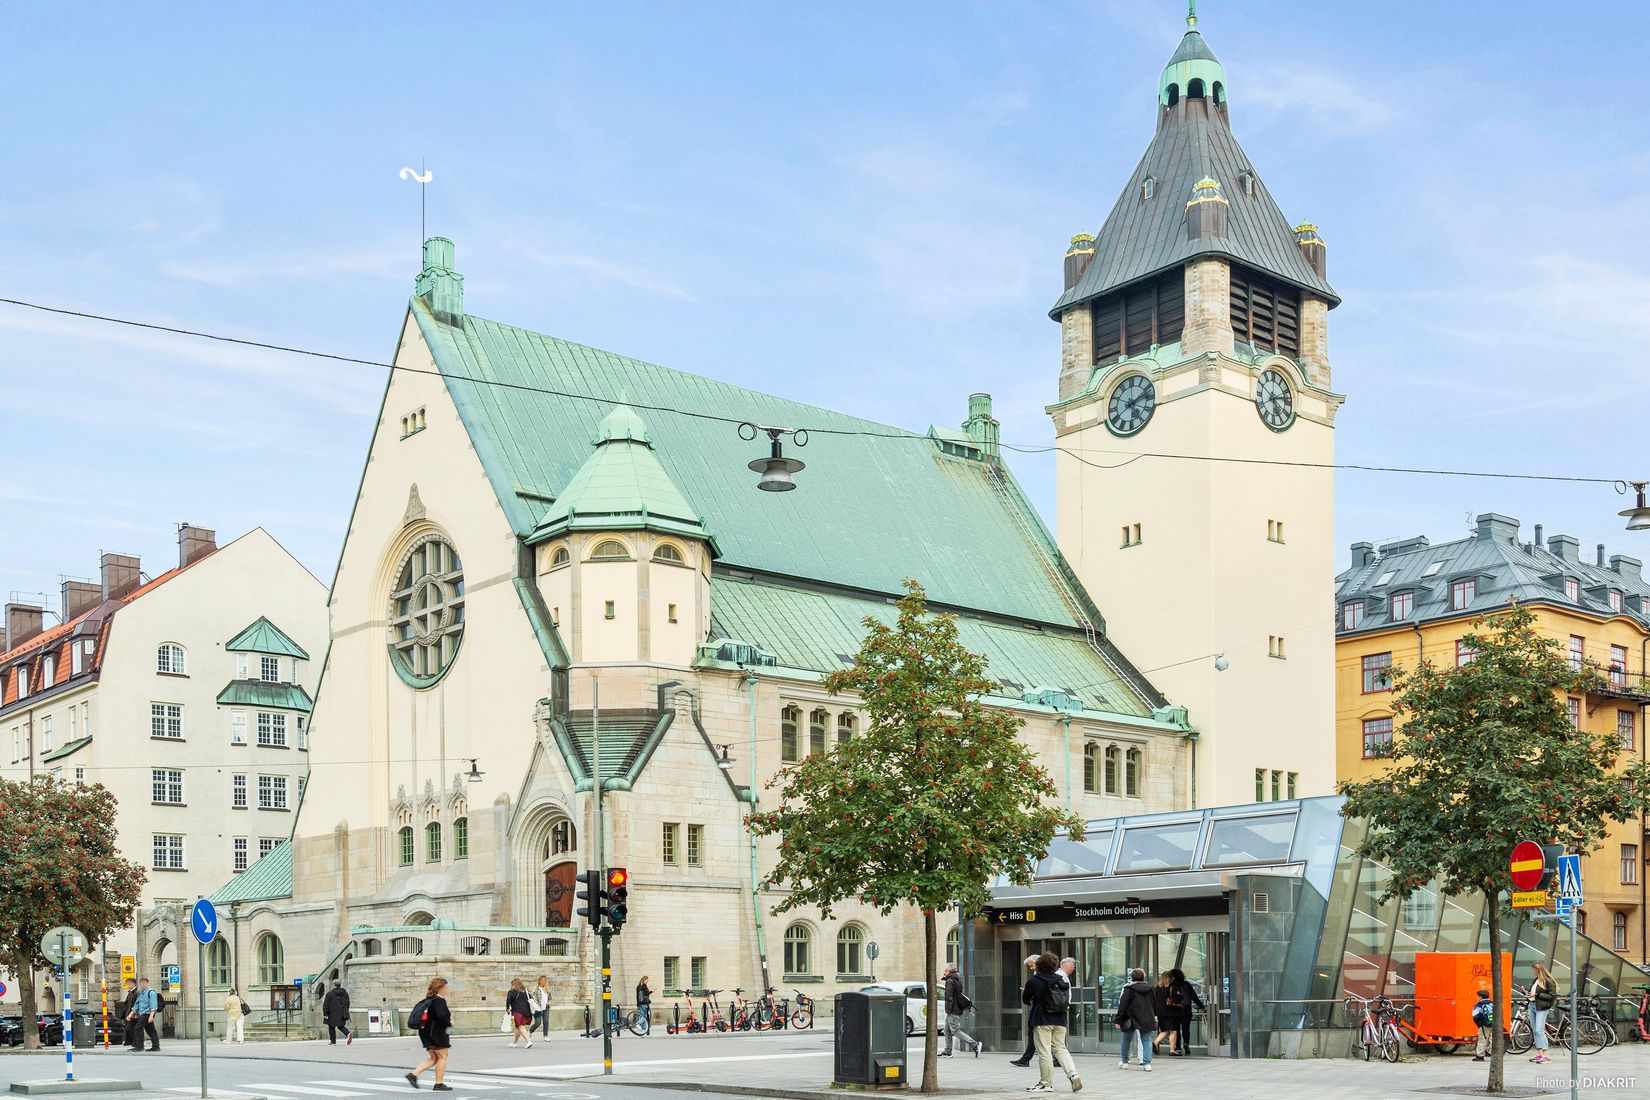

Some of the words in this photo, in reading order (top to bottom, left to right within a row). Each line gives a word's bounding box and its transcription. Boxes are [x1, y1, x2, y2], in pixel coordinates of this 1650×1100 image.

[1075, 906, 1113, 917] Stockholm
[1114, 904, 1150, 916] Odenplan
[1009, 911, 1024, 920] Hiss
[171, 967, 178, 975] P
